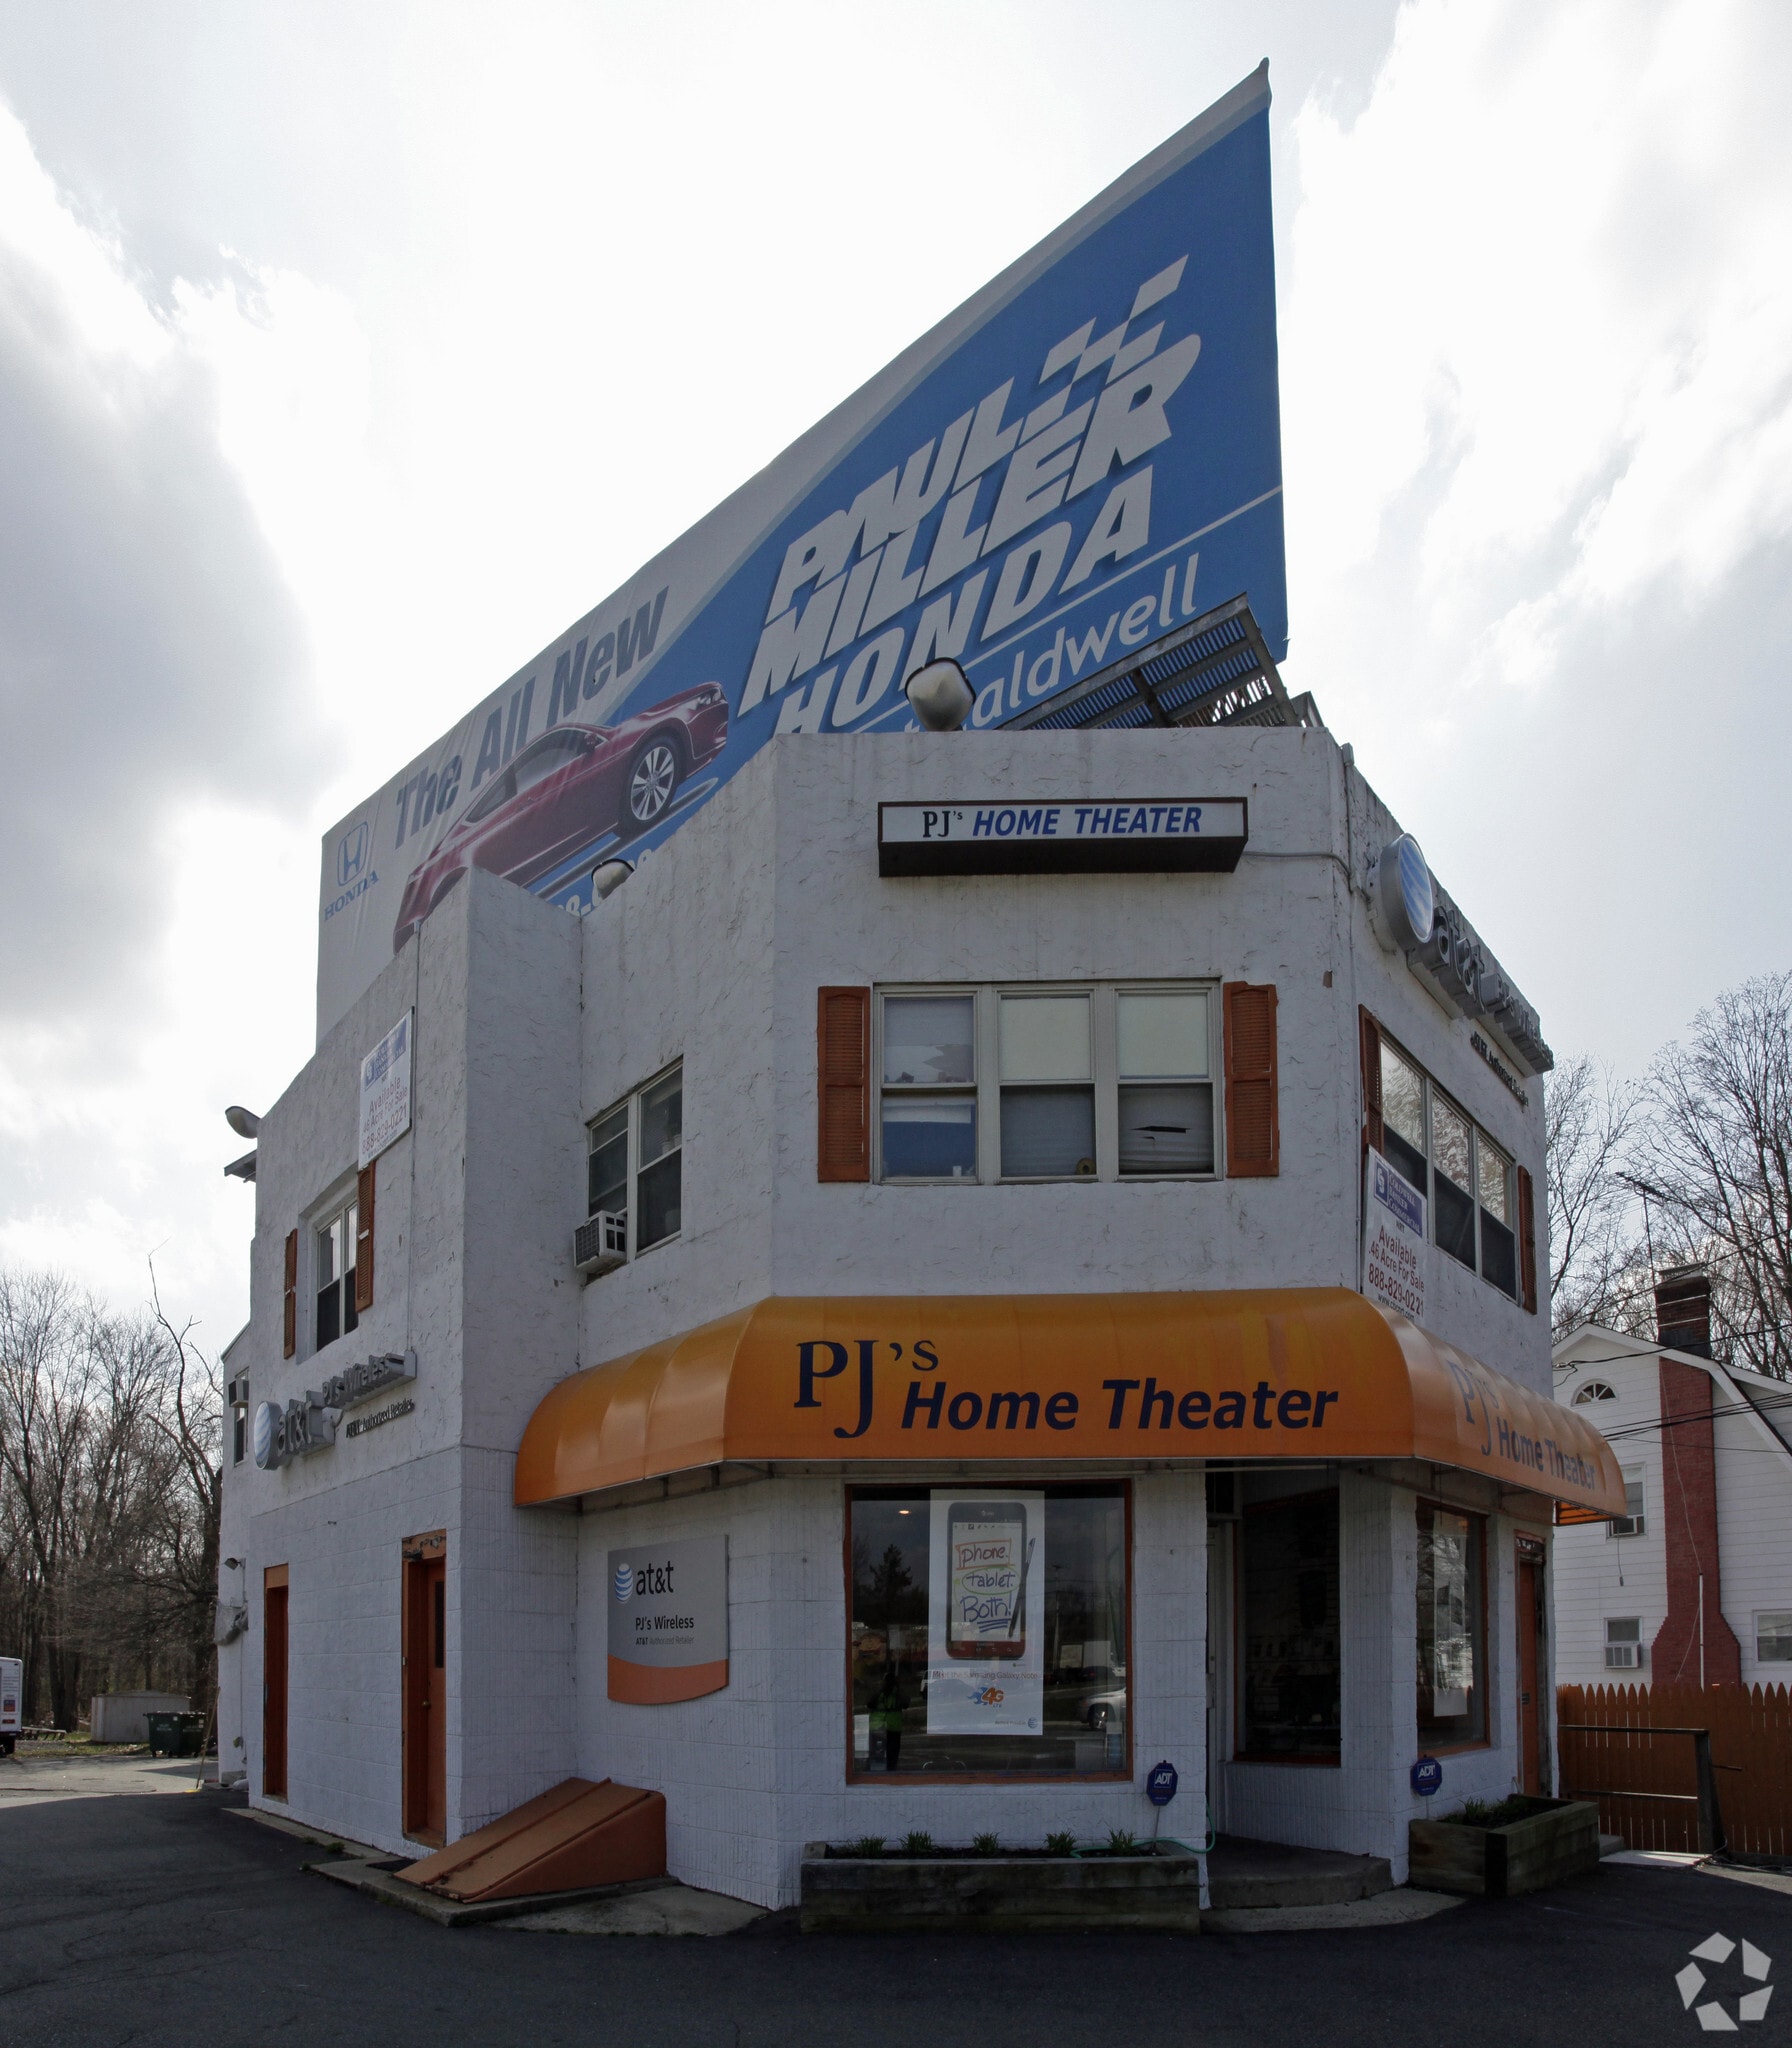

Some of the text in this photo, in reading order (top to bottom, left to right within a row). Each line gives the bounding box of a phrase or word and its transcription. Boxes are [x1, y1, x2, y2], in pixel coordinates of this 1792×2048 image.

[737, 334, 1201, 717] MILLER
[765, 375, 1024, 624] PAUL
[775, 465, 1153, 735] HONDA
[964, 553, 1199, 730] aldwell
[395, 585, 670, 850] The All New
[922, 806, 1203, 838] PJ's HOME THEATER
[323, 869, 379, 922] HONDA
[369, 1077, 401, 1115] Available
[394, 1086, 408, 1105] Sale
[1368, 1241, 1425, 1293] .46 Acre For Sale
[1379, 1225, 1417, 1269] Available
[1368, 1263, 1425, 1318] 888-829-0221
[793, 1338, 1339, 1439] PJ's Home Theater
[1496, 1417, 1544, 1472] Home
[1545, 1438, 1596, 1490] Theater
[635, 1560, 674, 1596] at&t
[635, 1615, 695, 1631] PJ's Wireless
[996, 1671, 1020, 1682] Galaxy
[1019, 1671, 1039, 1680] Note
[1154, 1772, 1173, 1785] ADT
[1417, 1765, 1436, 1779] ADT
